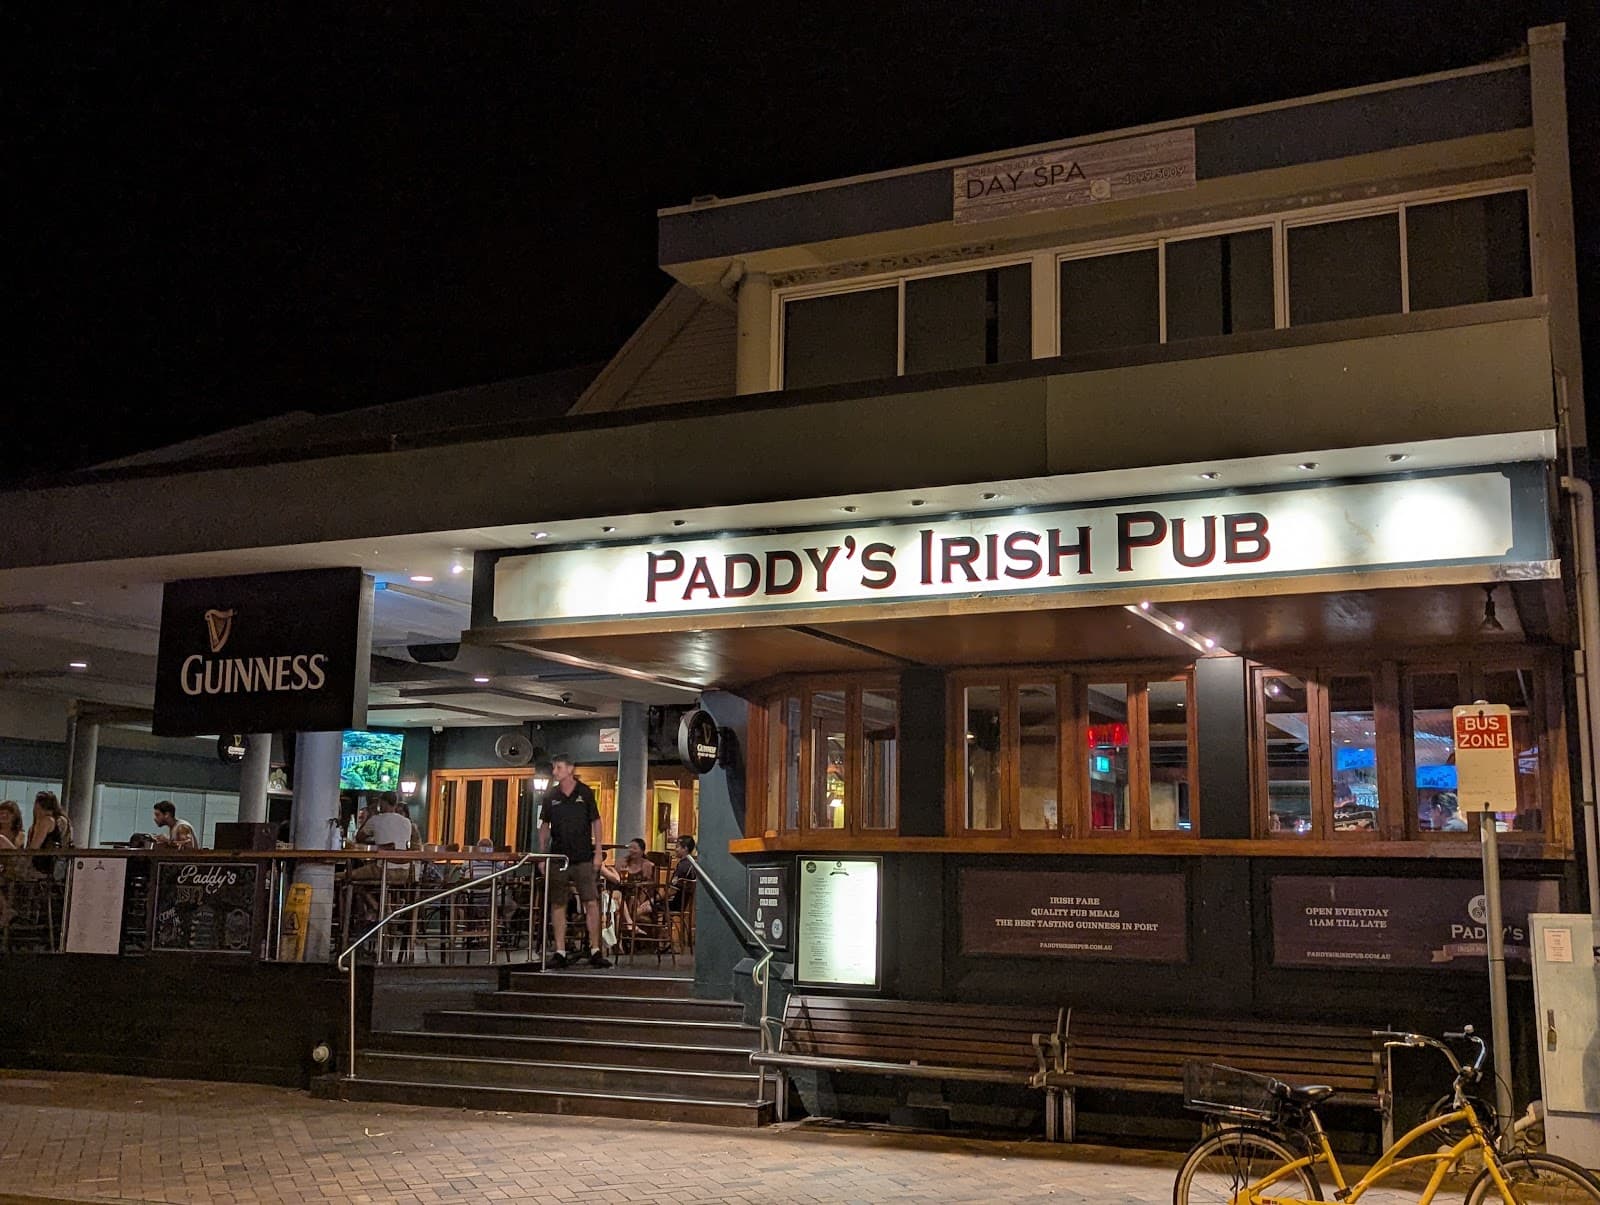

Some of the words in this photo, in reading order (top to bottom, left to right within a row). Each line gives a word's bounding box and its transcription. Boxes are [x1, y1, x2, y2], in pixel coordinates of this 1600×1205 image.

[966, 170, 1025, 199] DAY
[1033, 161, 1086, 188] SPA
[645, 534, 898, 603] PADDY'S
[919, 525, 1093, 586] IRISH
[1115, 509, 1272, 573] PUB
[180, 653, 326, 696] GUINNESS
[1465, 716, 1500, 731] BUS
[1459, 733, 1508, 748] ZONE
[177, 864, 237, 889] Paddy's
[1049, 896, 1074, 905] IRISH
[1075, 897, 1100, 906] FARE
[1030, 908, 1069, 918] QUALITY
[1070, 909, 1088, 918] PUB
[1089, 909, 1120, 919] MEALS
[1305, 907, 1333, 916] OPEN
[1334, 907, 1389, 917] EVERYDAY
[995, 918, 1013, 927] THE
[1014, 919, 1037, 928] BEST
[1037, 919, 1075, 929] TASTING
[1075, 920, 1121, 930] GUINNESS
[1122, 922, 1132, 931] IN
[1134, 923, 1159, 932] PORT
[1309, 918, 1334, 927] 11AM
[1336, 919, 1359, 928] TILL
[1360, 919, 1388, 929] LATE
[1451, 924, 1525, 941] PADY'S
